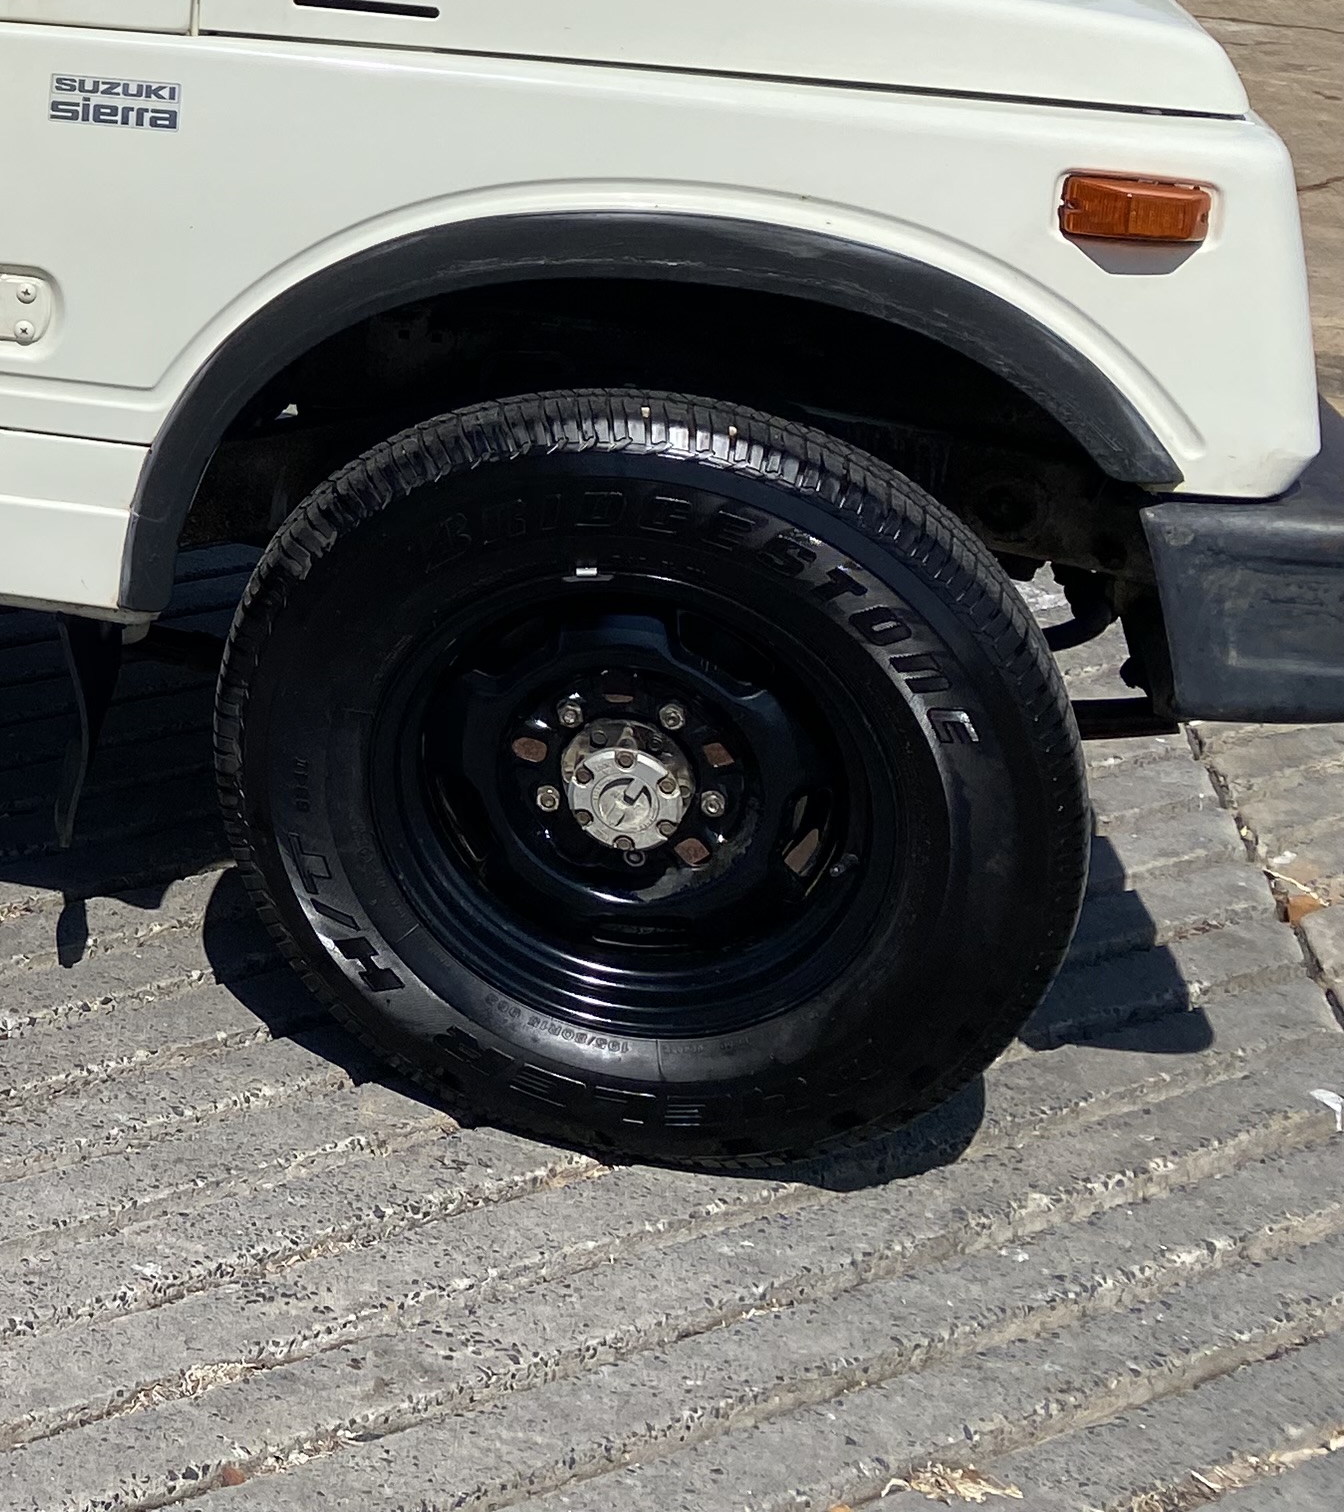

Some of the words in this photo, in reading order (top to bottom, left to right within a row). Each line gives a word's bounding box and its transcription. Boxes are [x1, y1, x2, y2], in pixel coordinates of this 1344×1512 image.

[50, 96, 178, 130] sierra
[55, 77, 176, 101] SUZUKI
[422, 488, 985, 751] BRIDGESTONE
[288, 830, 406, 993] H/T
